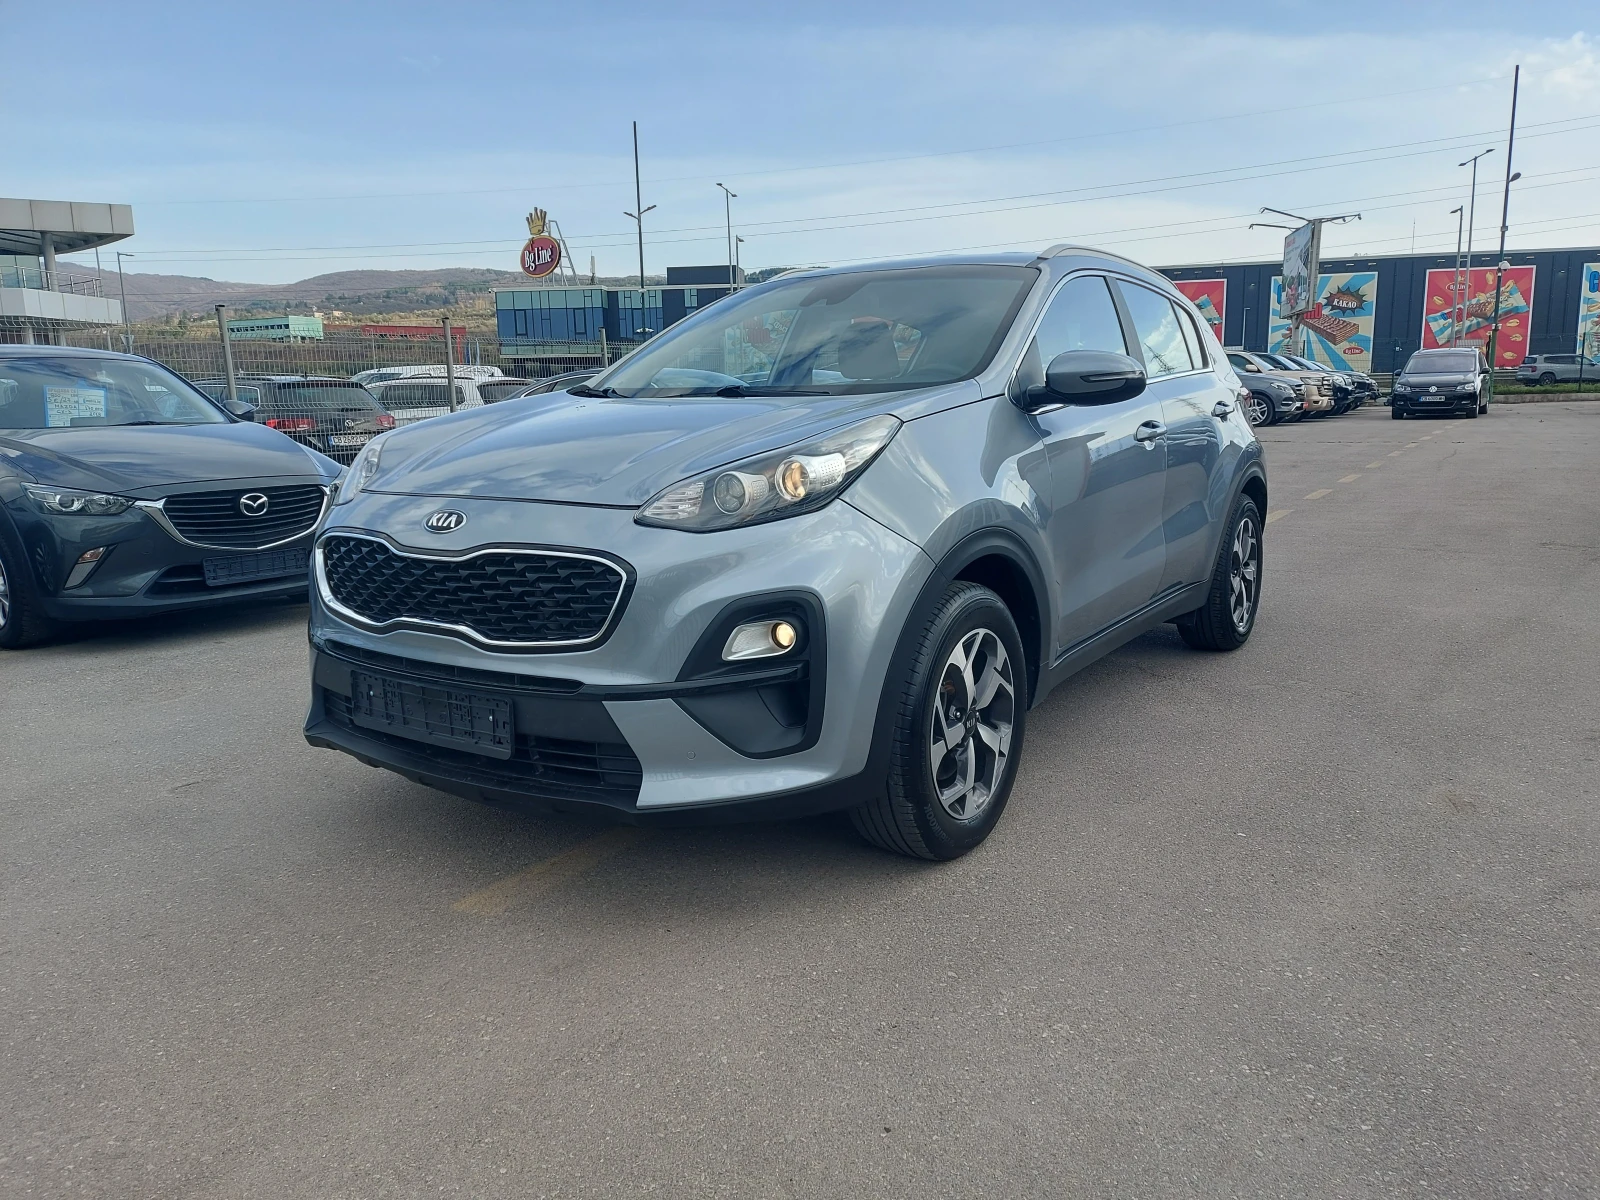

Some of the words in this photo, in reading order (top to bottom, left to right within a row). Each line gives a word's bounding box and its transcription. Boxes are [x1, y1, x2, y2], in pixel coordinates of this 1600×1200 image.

[524, 250, 535, 271] Bg
[534, 246, 552, 265] Line
[1333, 298, 1357, 309] KAKAO
[428, 513, 458, 528] KIA
[966, 717, 976, 729] KIA
